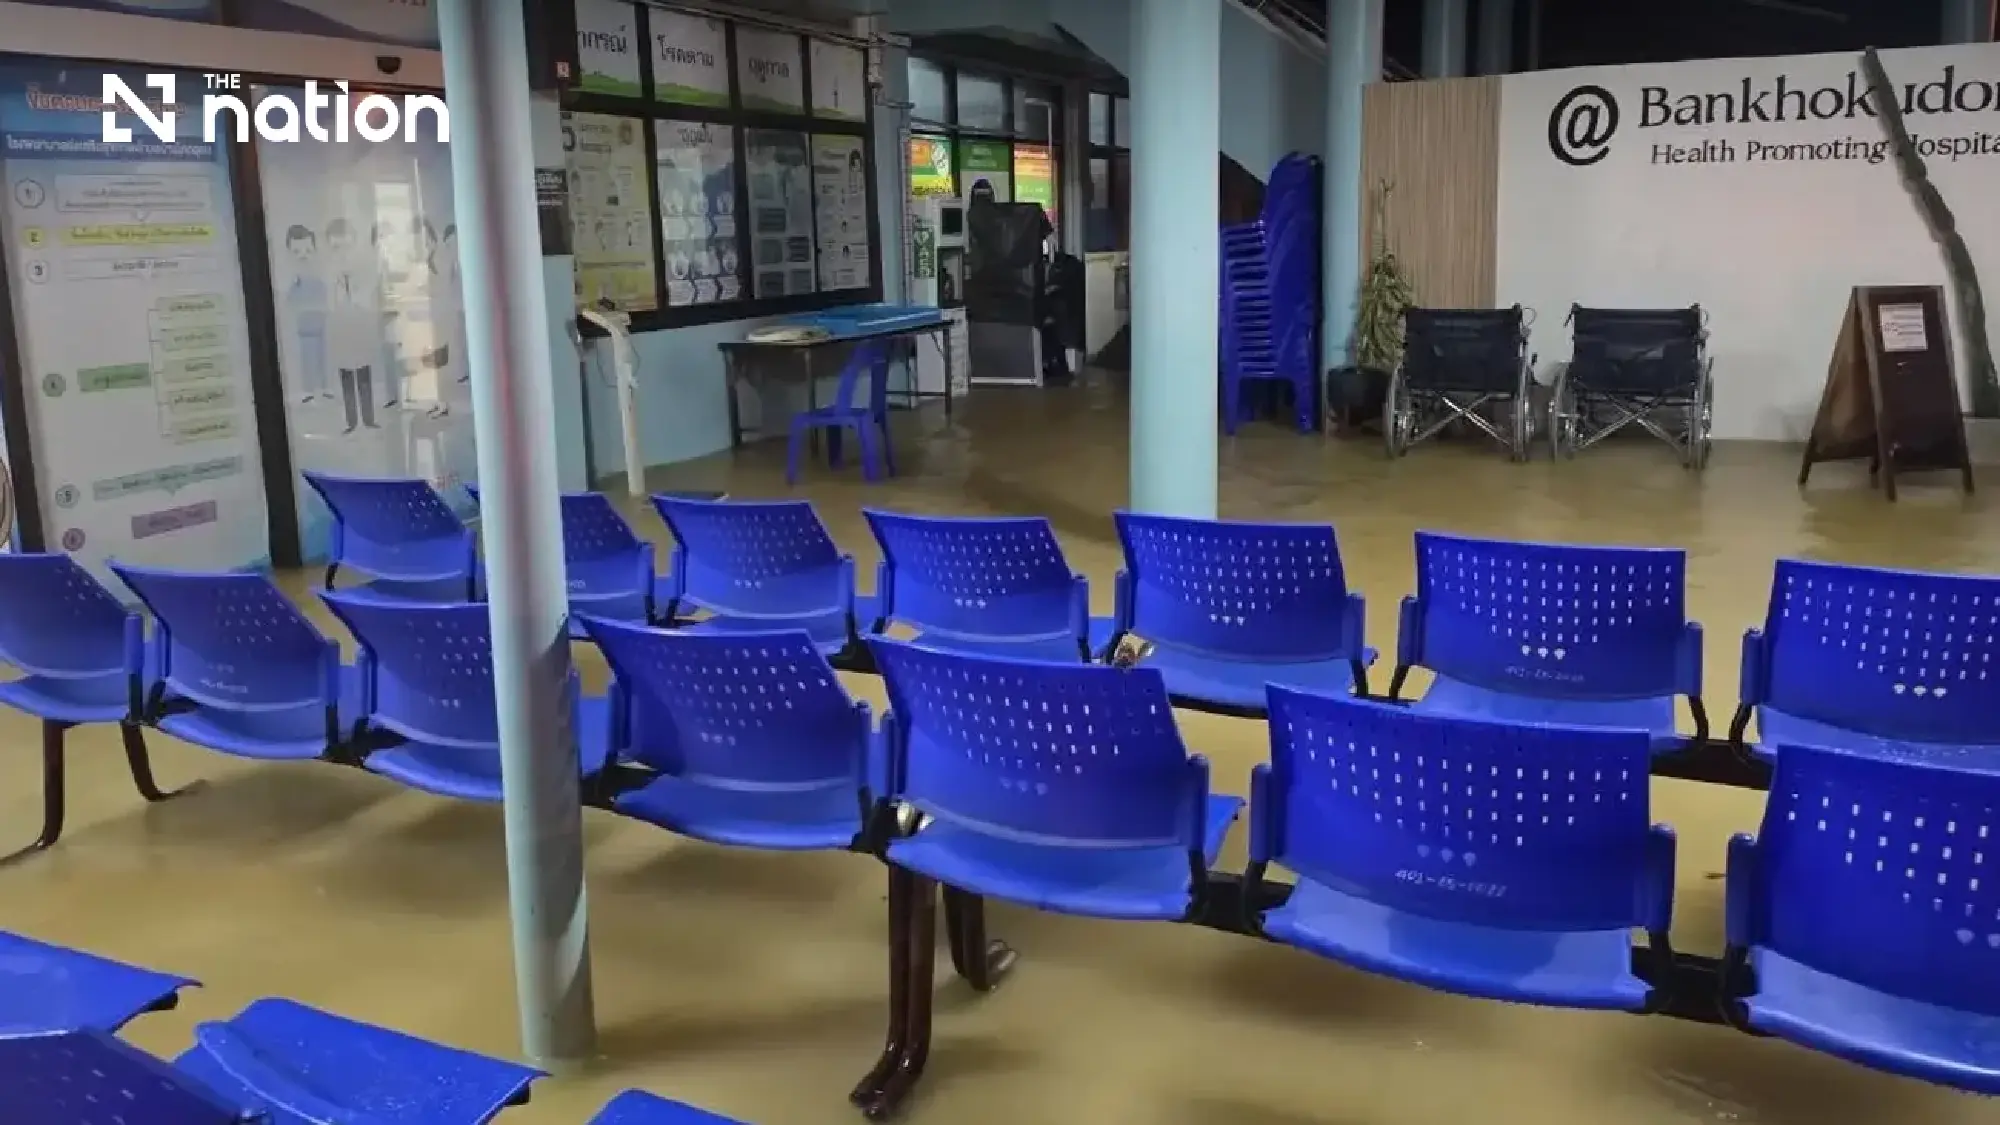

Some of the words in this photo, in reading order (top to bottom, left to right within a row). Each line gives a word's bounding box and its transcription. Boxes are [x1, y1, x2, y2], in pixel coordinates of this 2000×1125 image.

[1548, 85, 1620, 166] @
[1638, 65, 2000, 128] Bankhokdo
[1651, 139, 1735, 164] Health
[1747, 136, 1890, 164] Promoting
